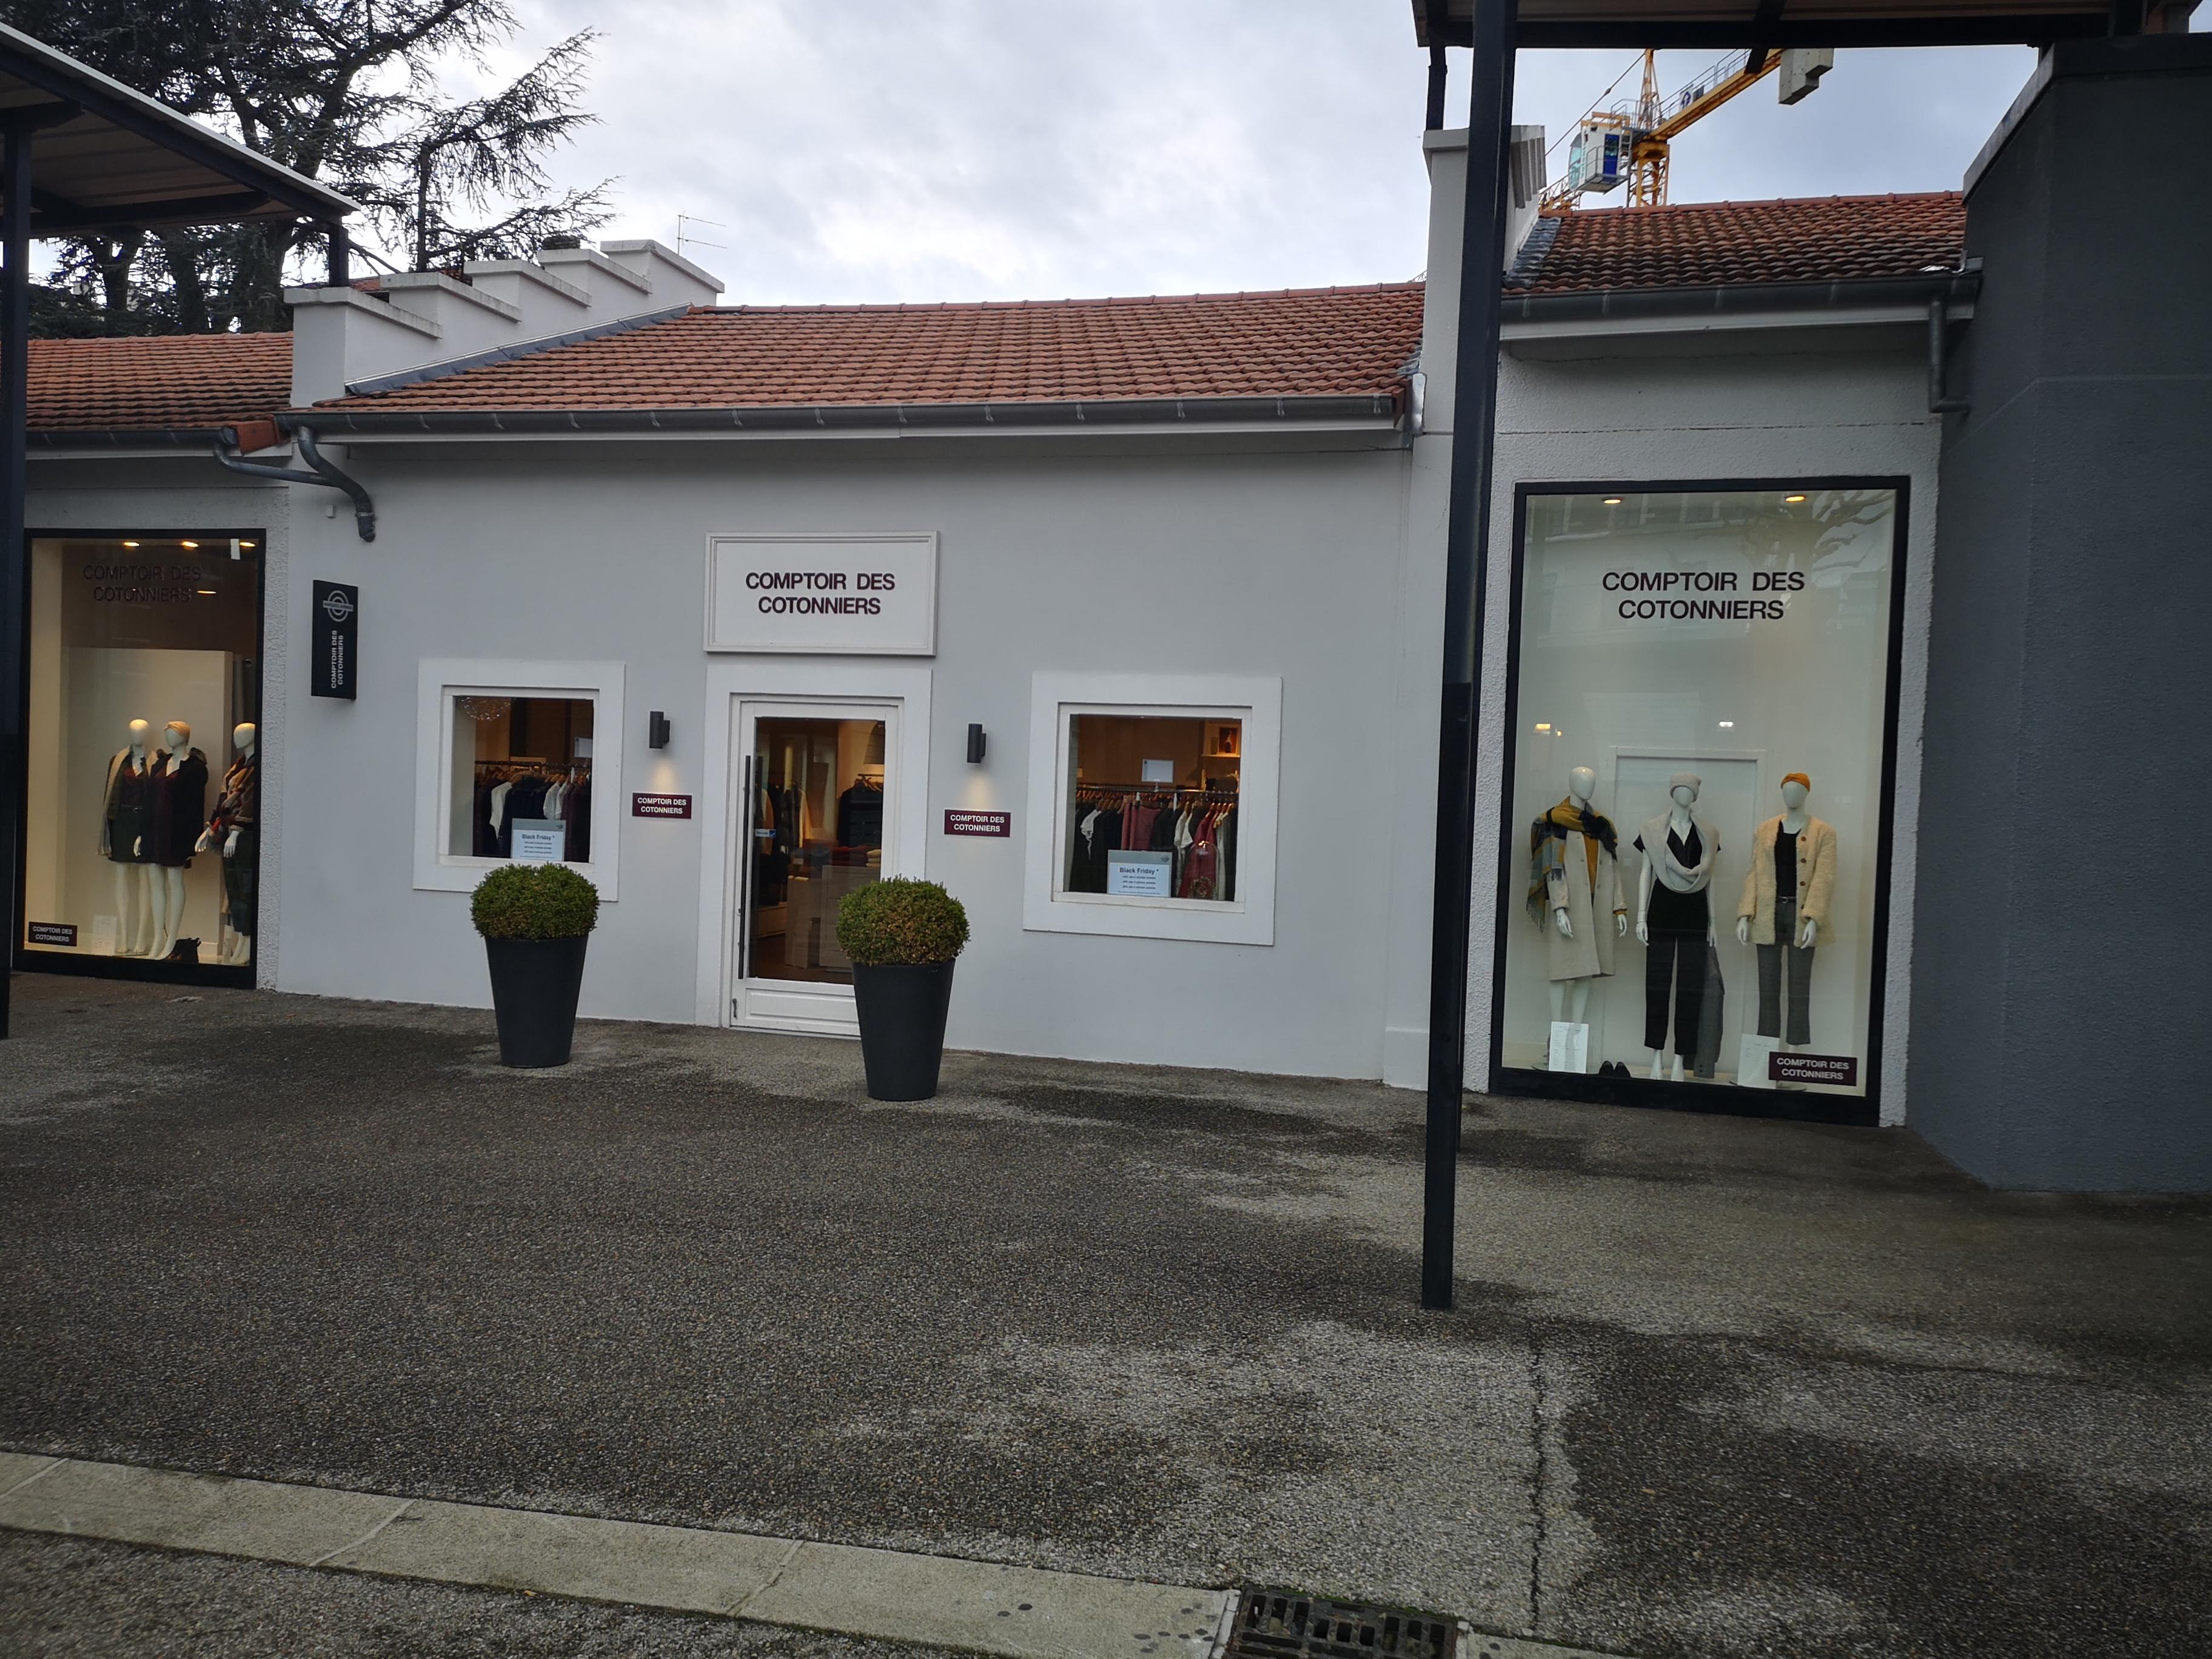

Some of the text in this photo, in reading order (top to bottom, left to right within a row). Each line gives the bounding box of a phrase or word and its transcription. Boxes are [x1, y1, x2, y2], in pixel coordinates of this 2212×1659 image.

[171, 566, 201, 581] DES
[746, 572, 896, 591] COMPTOIR DES
[1602, 572, 1805, 591] COMPTOIR DES
[758, 597, 881, 615] COTONNIERS
[1618, 600, 1785, 620] COTONNIERS
[637, 797, 672, 805] COMPTOIR
[640, 806, 683, 814] COTONNIERS
[954, 823, 1000, 832] COTONNIERS
[1777, 1057, 1849, 1070] COMPTOIR DES
[1781, 1068, 1844, 1080] COTONNIERS
